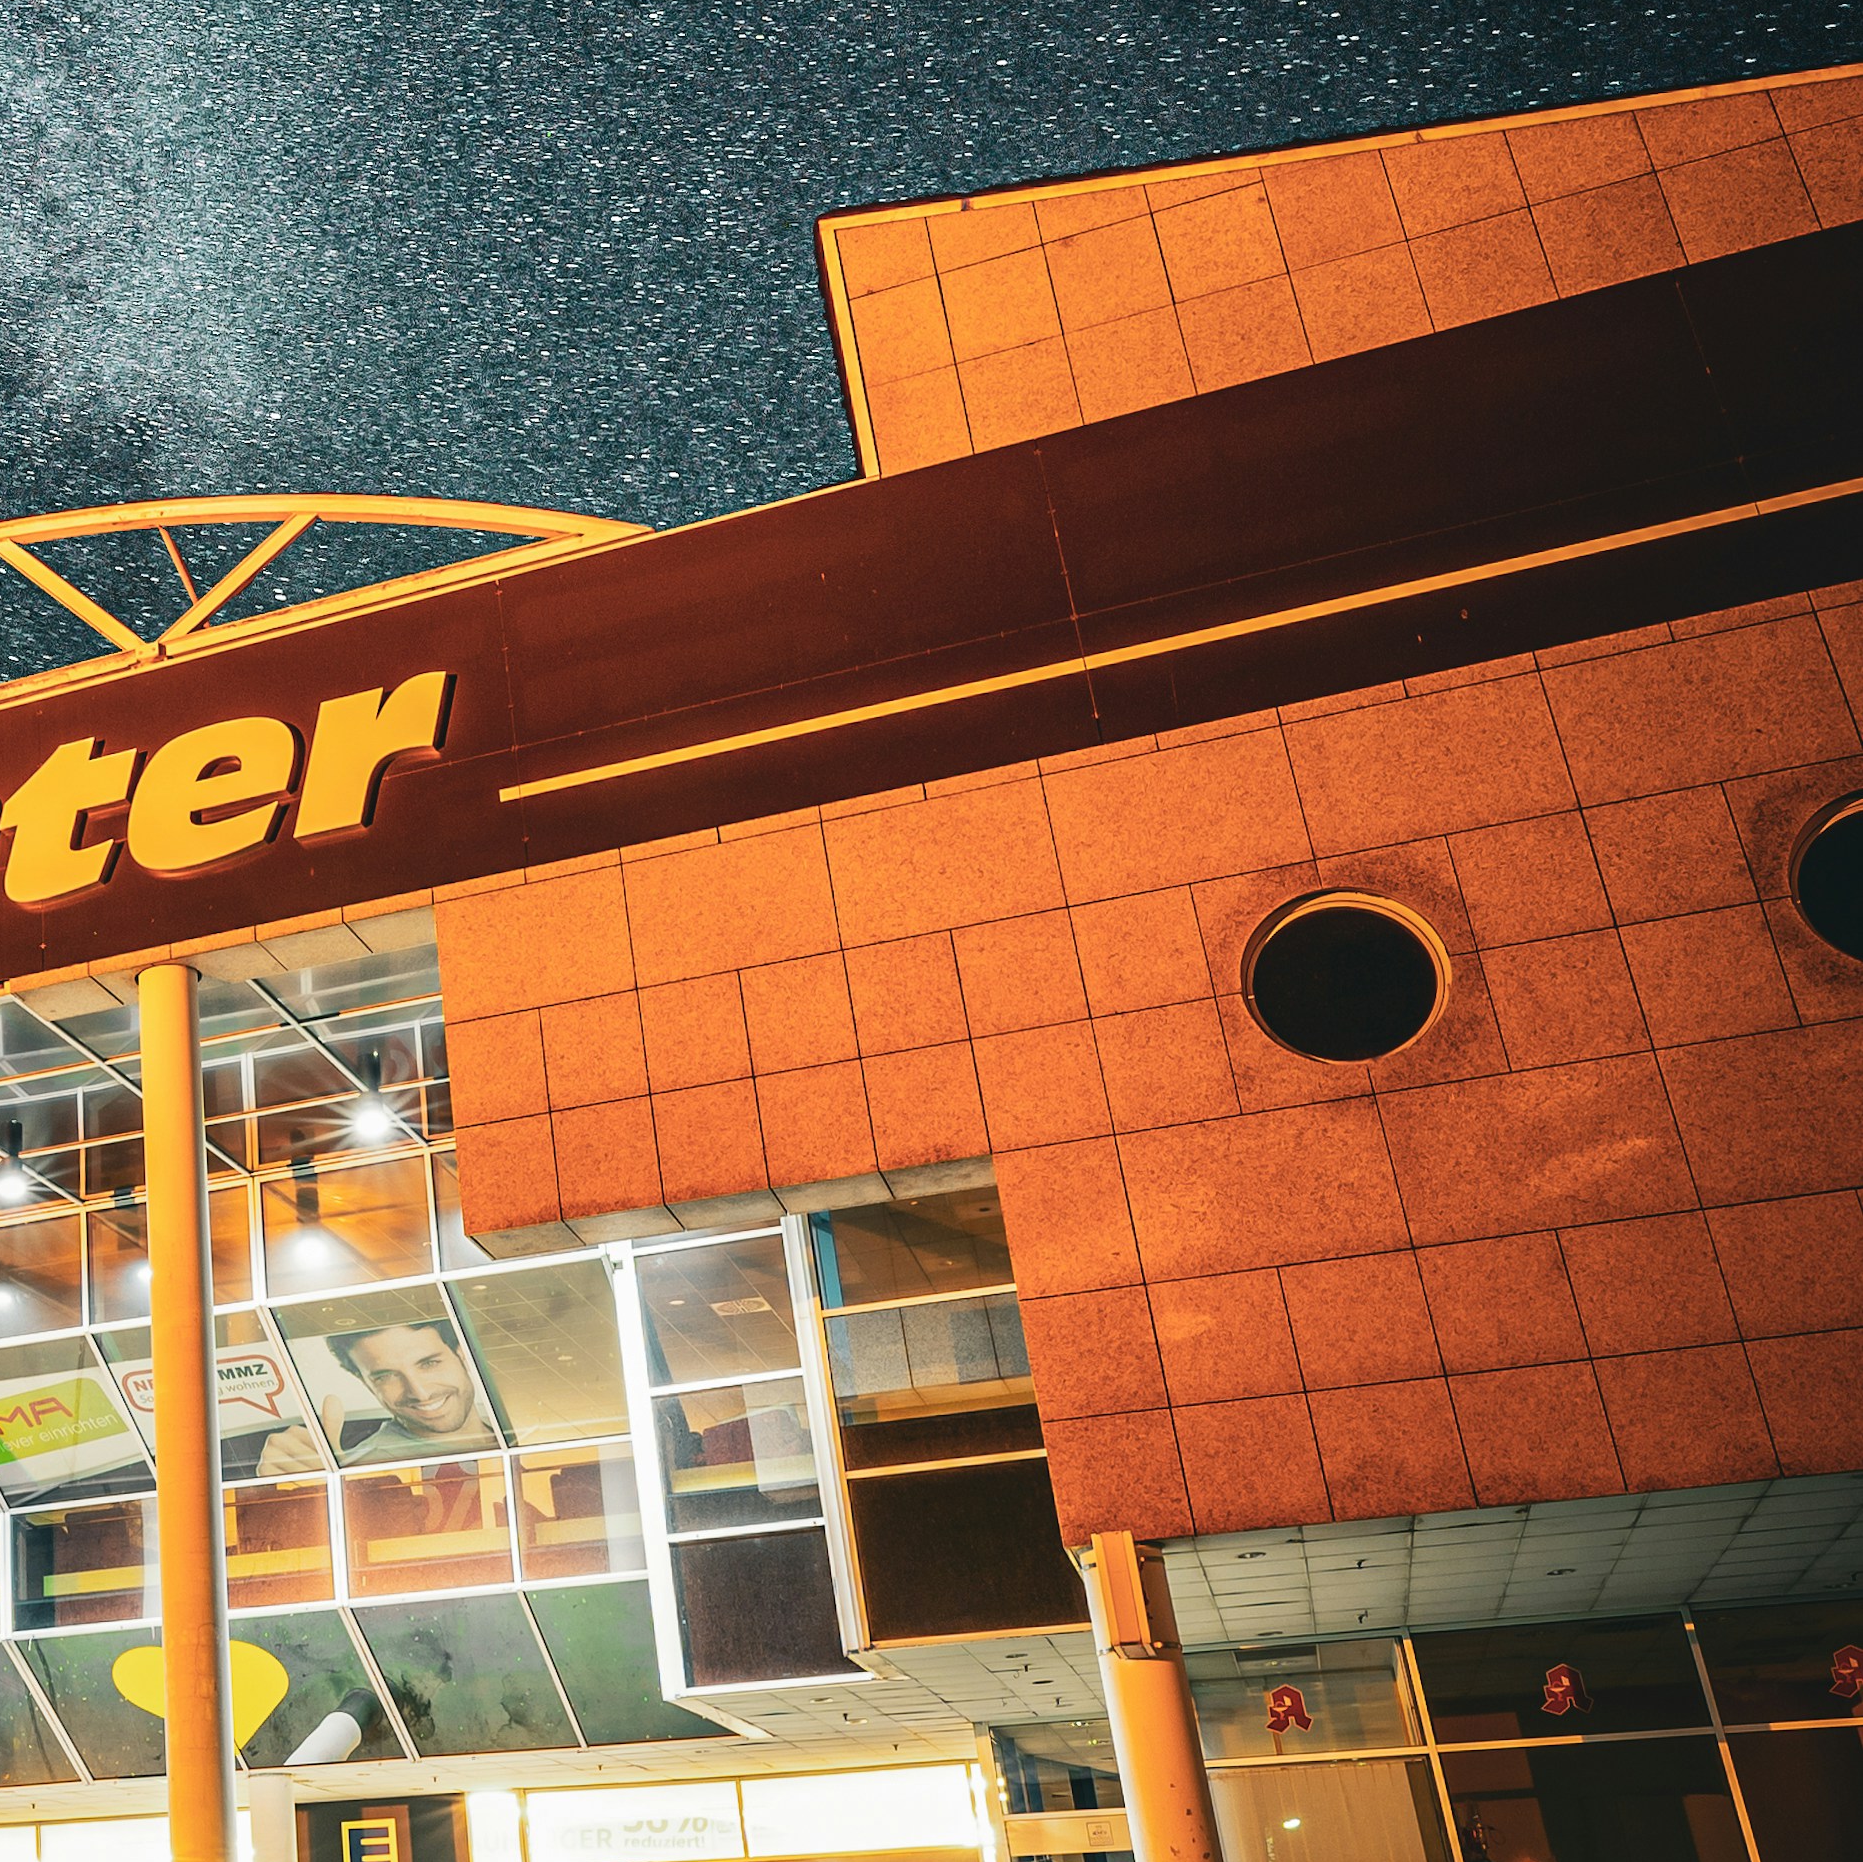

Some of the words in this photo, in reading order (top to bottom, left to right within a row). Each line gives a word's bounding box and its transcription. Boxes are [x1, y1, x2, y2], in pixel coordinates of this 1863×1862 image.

[226, 1377, 278, 1393] wohnen.
[39, 1412, 119, 1442] einrichten
[623, 1835, 705, 1849] reduziert!
